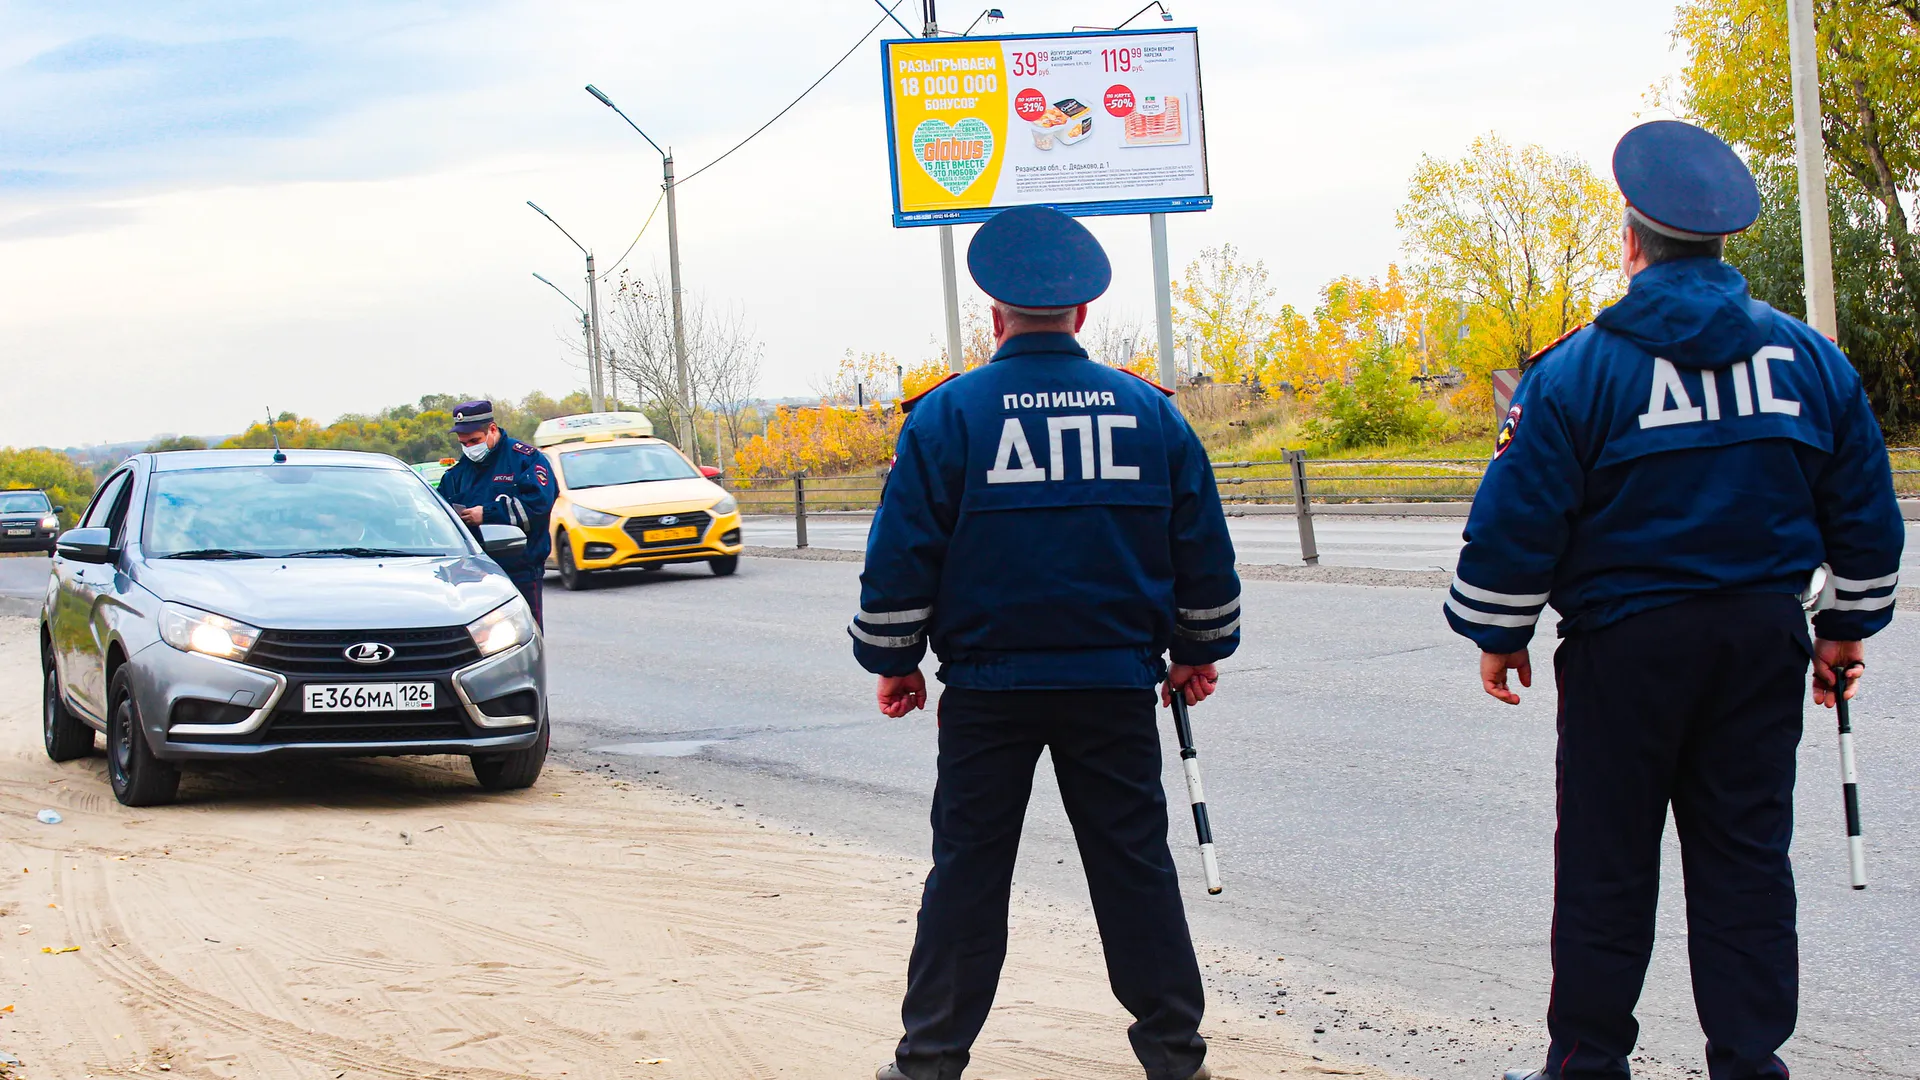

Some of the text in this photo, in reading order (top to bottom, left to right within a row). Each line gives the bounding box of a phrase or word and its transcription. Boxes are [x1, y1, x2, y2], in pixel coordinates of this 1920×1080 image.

[900, 57, 996, 73] РАЗЫГРЫВАЕМ
[1012, 51, 1048, 76] 39 99
[1101, 48, 1142, 72] 119 99
[900, 74, 997, 96] 18 000 000
[1018, 102, 1044, 112] -31%
[1106, 98, 1133, 109] -50%
[924, 160, 985, 170] 15 ЛЕТ ВМЕСТЕ
[1638, 346, 1800, 429] ДПС
[1003, 391, 1115, 409] ПОЛИЦИЯ
[987, 415, 1140, 484] ДПС
[312, 685, 428, 708] Е366МА 126
